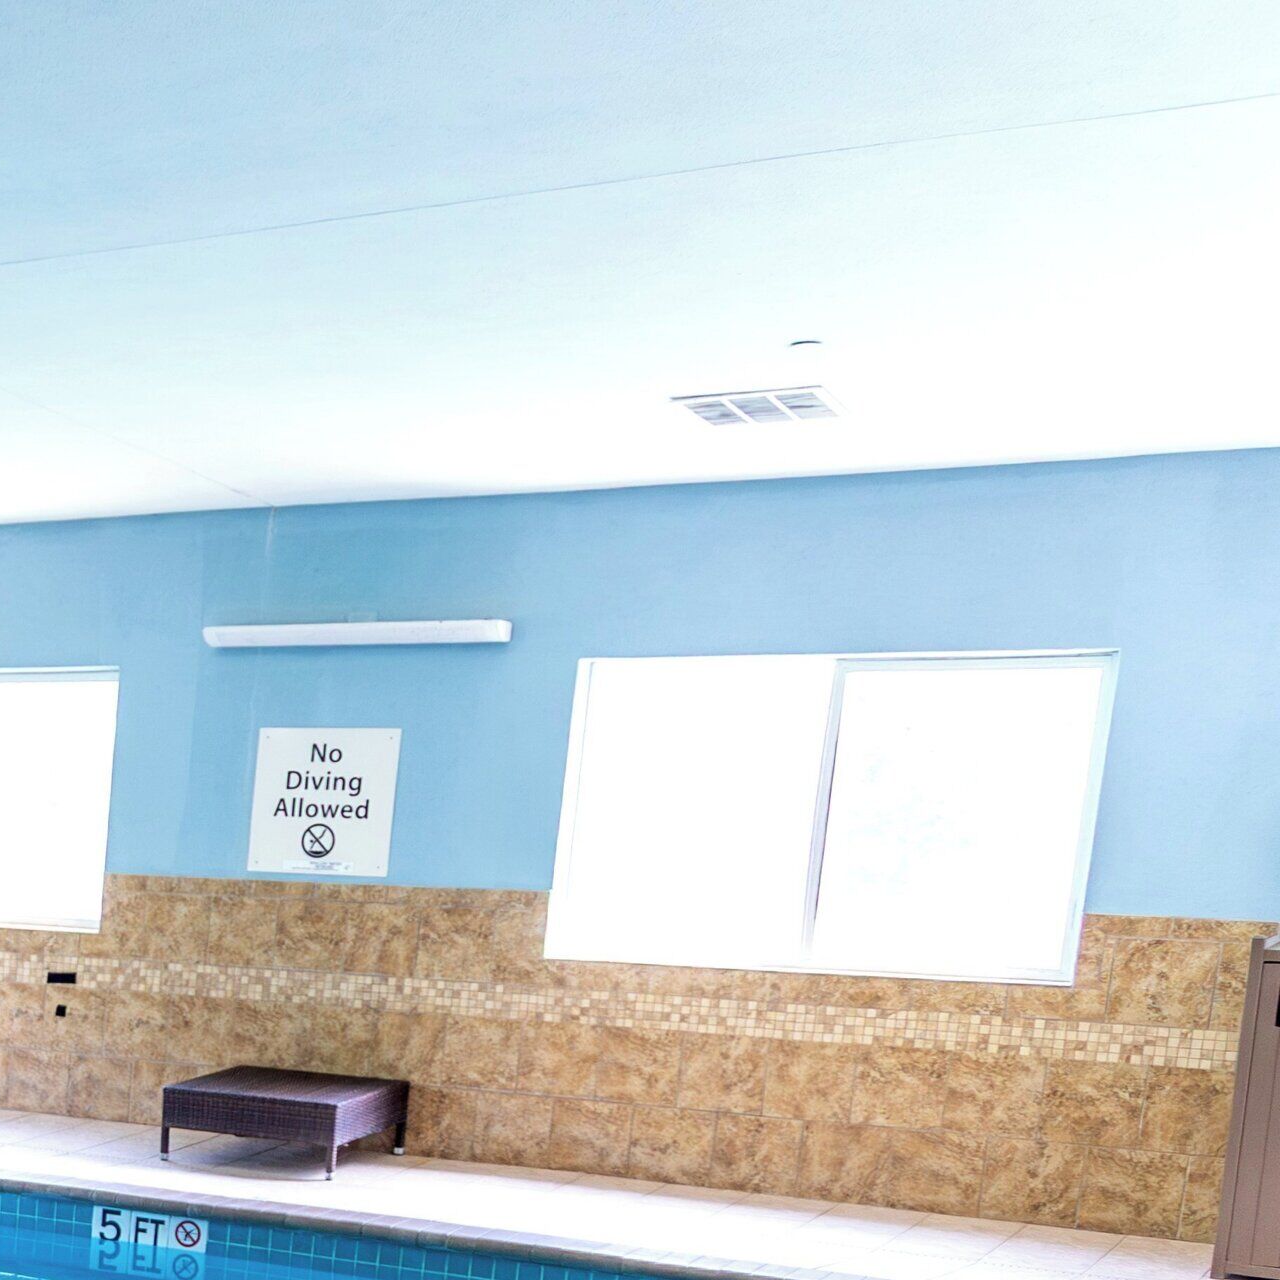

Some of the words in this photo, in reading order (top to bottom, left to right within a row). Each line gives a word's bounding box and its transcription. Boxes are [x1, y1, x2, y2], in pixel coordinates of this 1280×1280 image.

[310, 743, 343, 763] No
[286, 770, 362, 797] Diving
[273, 797, 370, 819] Allowed
[99, 1208, 122, 1241] 5
[134, 1216, 166, 1246] FT
